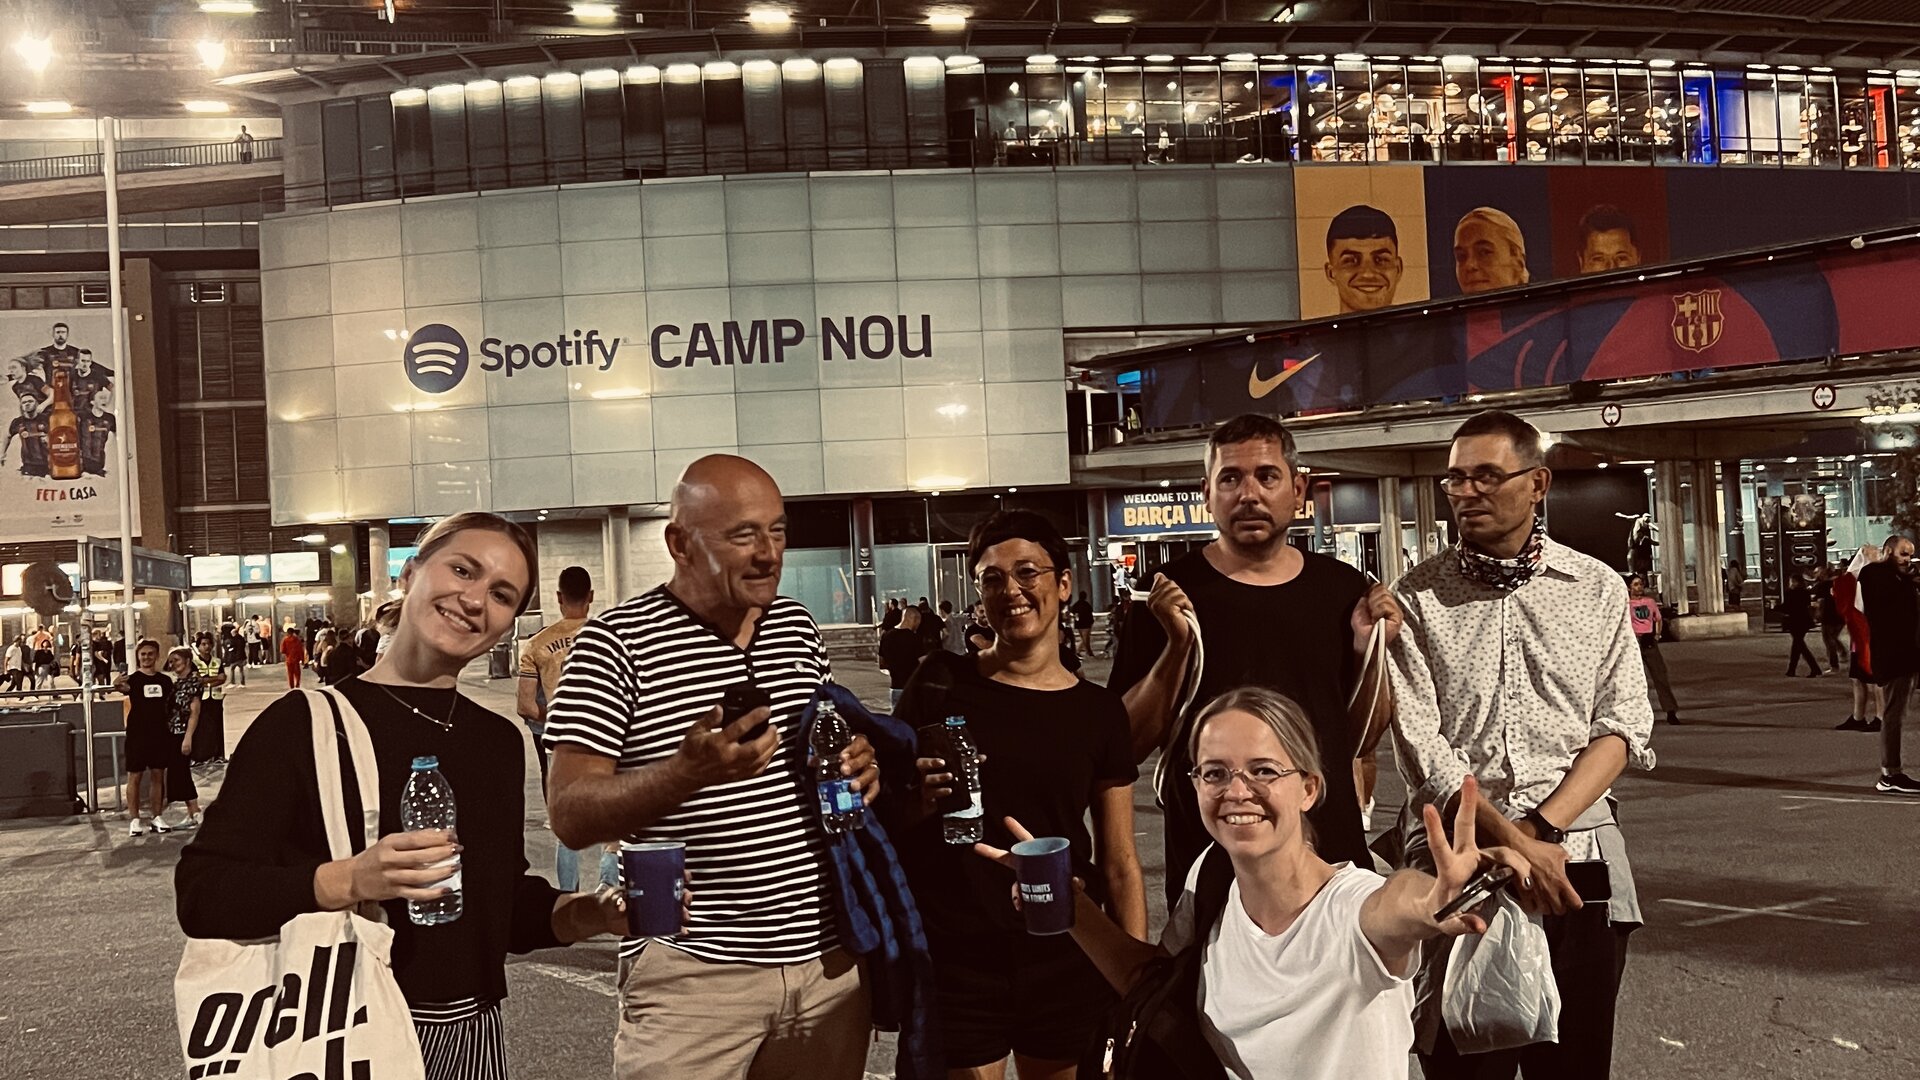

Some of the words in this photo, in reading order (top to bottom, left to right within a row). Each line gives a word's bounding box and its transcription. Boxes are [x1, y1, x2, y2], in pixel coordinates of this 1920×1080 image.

[479, 329, 620, 377] Spotify
[651, 319, 805, 368] CAMP
[821, 314, 932, 361] NOU
[36, 488, 58, 501] FET
[59, 490, 66, 500] A
[70, 486, 97, 500] CASA
[1124, 492, 1174, 504] WELCOME
[1176, 491, 1189, 502] TO
[1123, 504, 1186, 528] BARÇA
